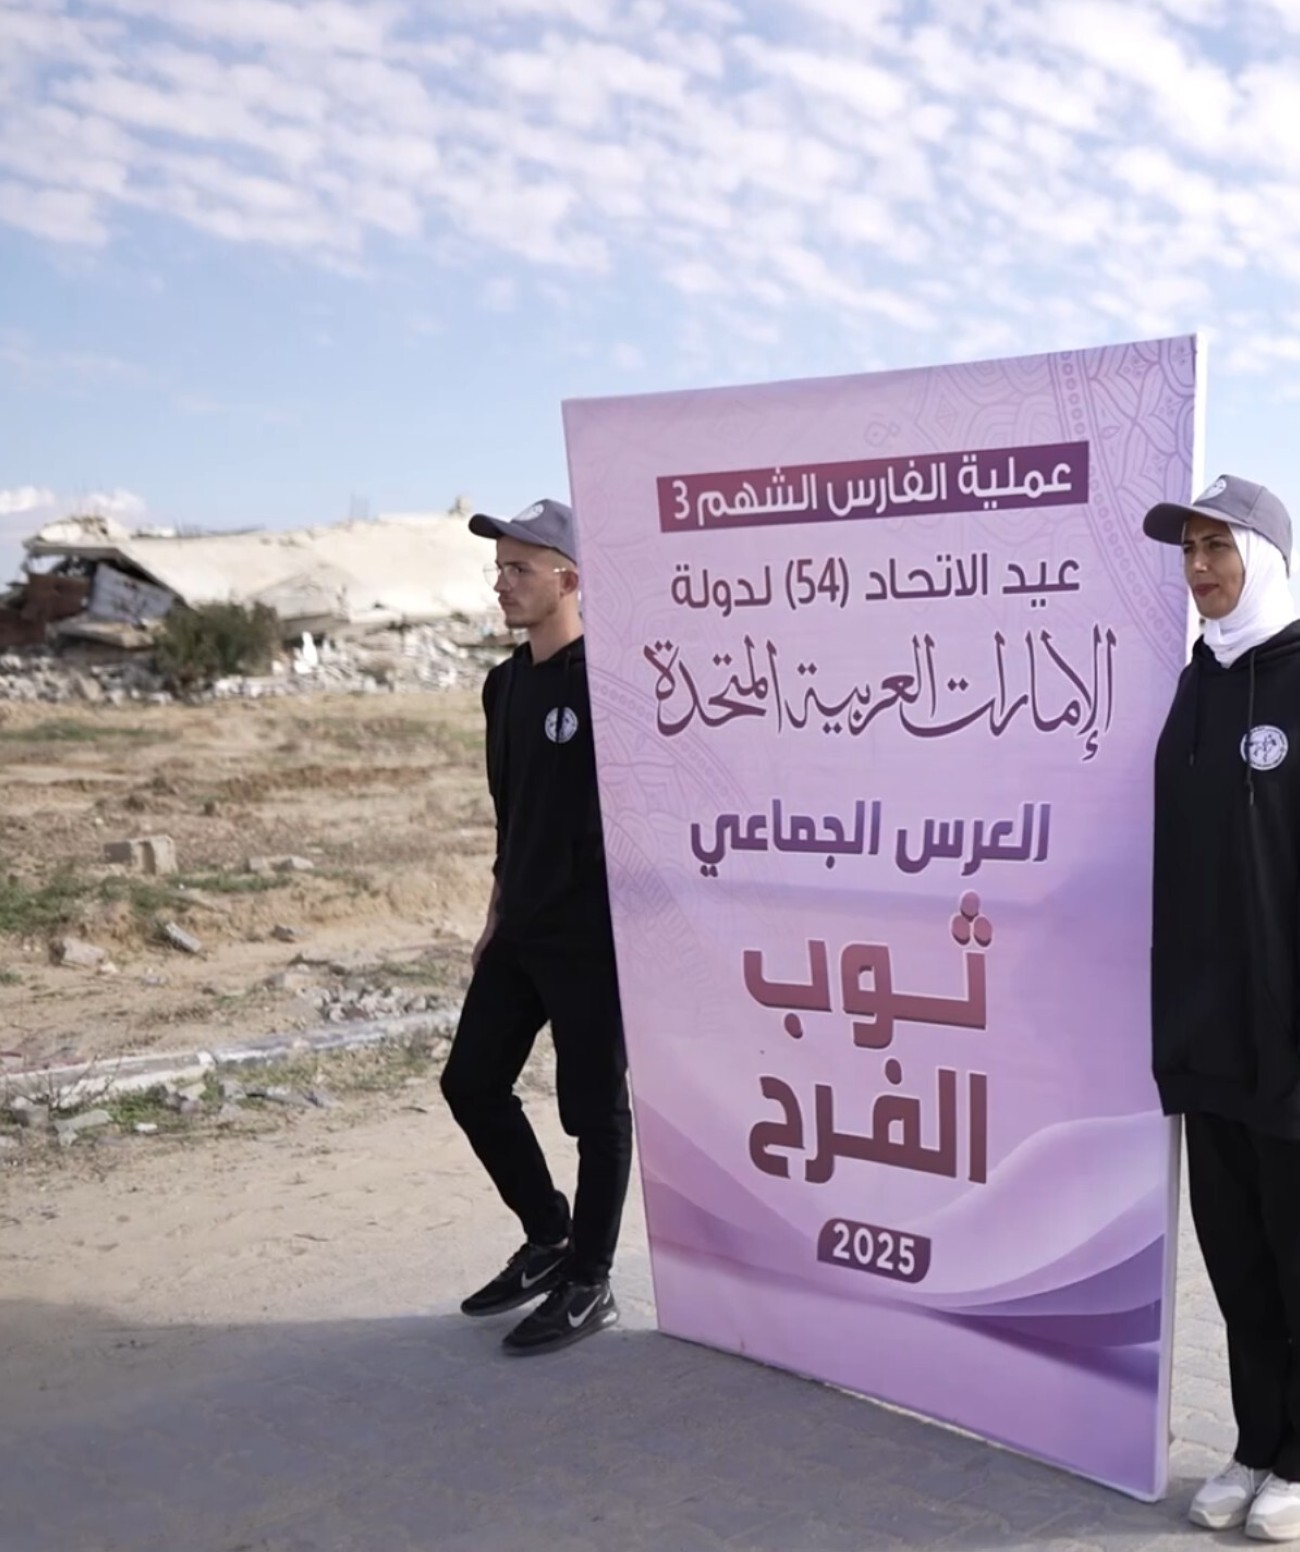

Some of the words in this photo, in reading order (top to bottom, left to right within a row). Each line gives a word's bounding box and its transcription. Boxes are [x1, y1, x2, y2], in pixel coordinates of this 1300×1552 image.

[673, 480, 690, 519] 3
[698, 467, 817, 526] الشهم
[826, 459, 946, 517] الفارس
[958, 455, 1072, 509] عملية
[671, 563, 771, 617] لدولة
[785, 558, 849, 610] (54)
[866, 553, 988, 601] الاتحاد
[1002, 559, 1080, 606] عيد
[643, 635, 781, 736] المتحدة
[787, 634, 937, 736] العربية
[900, 624, 1116, 761] الإمارات
[691, 800, 881, 877] الجماعي
[896, 804, 1050, 875] العرس
[743, 892, 992, 1049] ثوب
[749, 1058, 988, 1184] الفرح
[833, 1223, 915, 1274] 2025
